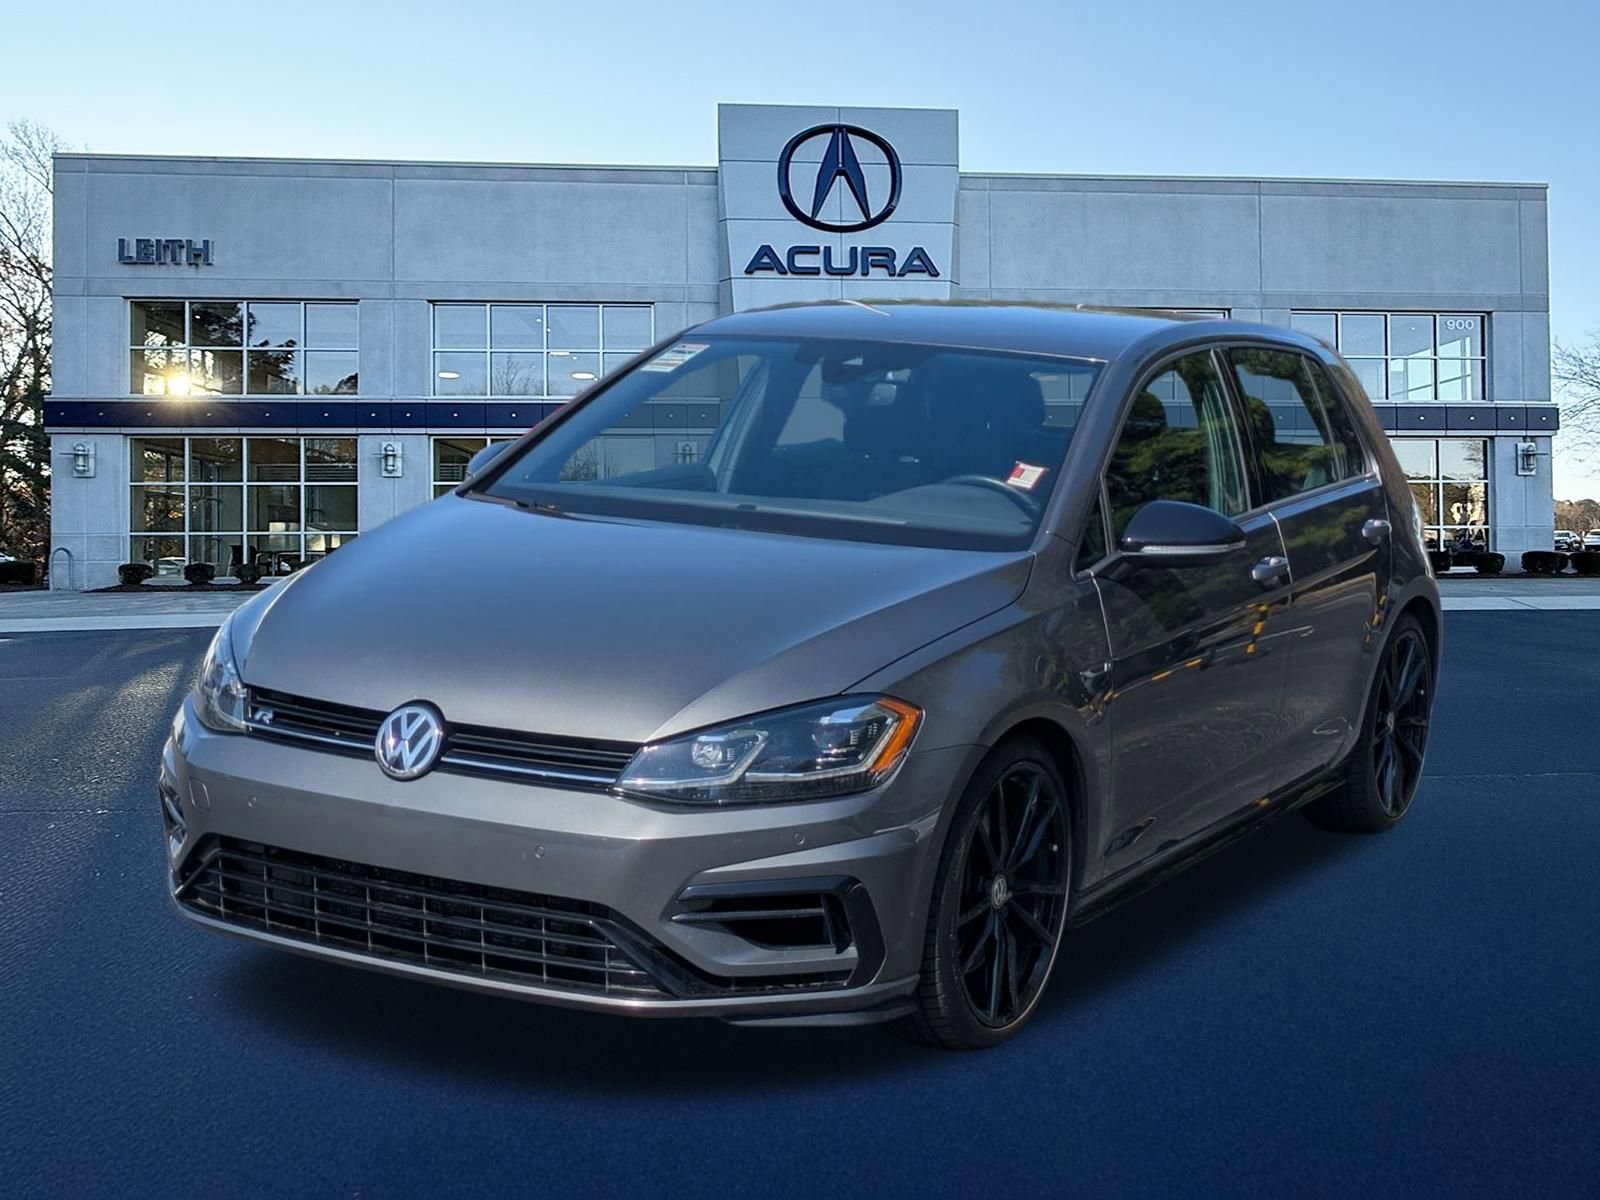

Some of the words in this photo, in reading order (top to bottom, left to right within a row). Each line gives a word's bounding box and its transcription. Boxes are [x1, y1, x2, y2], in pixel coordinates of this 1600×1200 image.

[117, 238, 212, 265] LEITH
[744, 244, 941, 277] ACURA
[1446, 319, 1474, 330] 900
[254, 707, 275, 724] R
